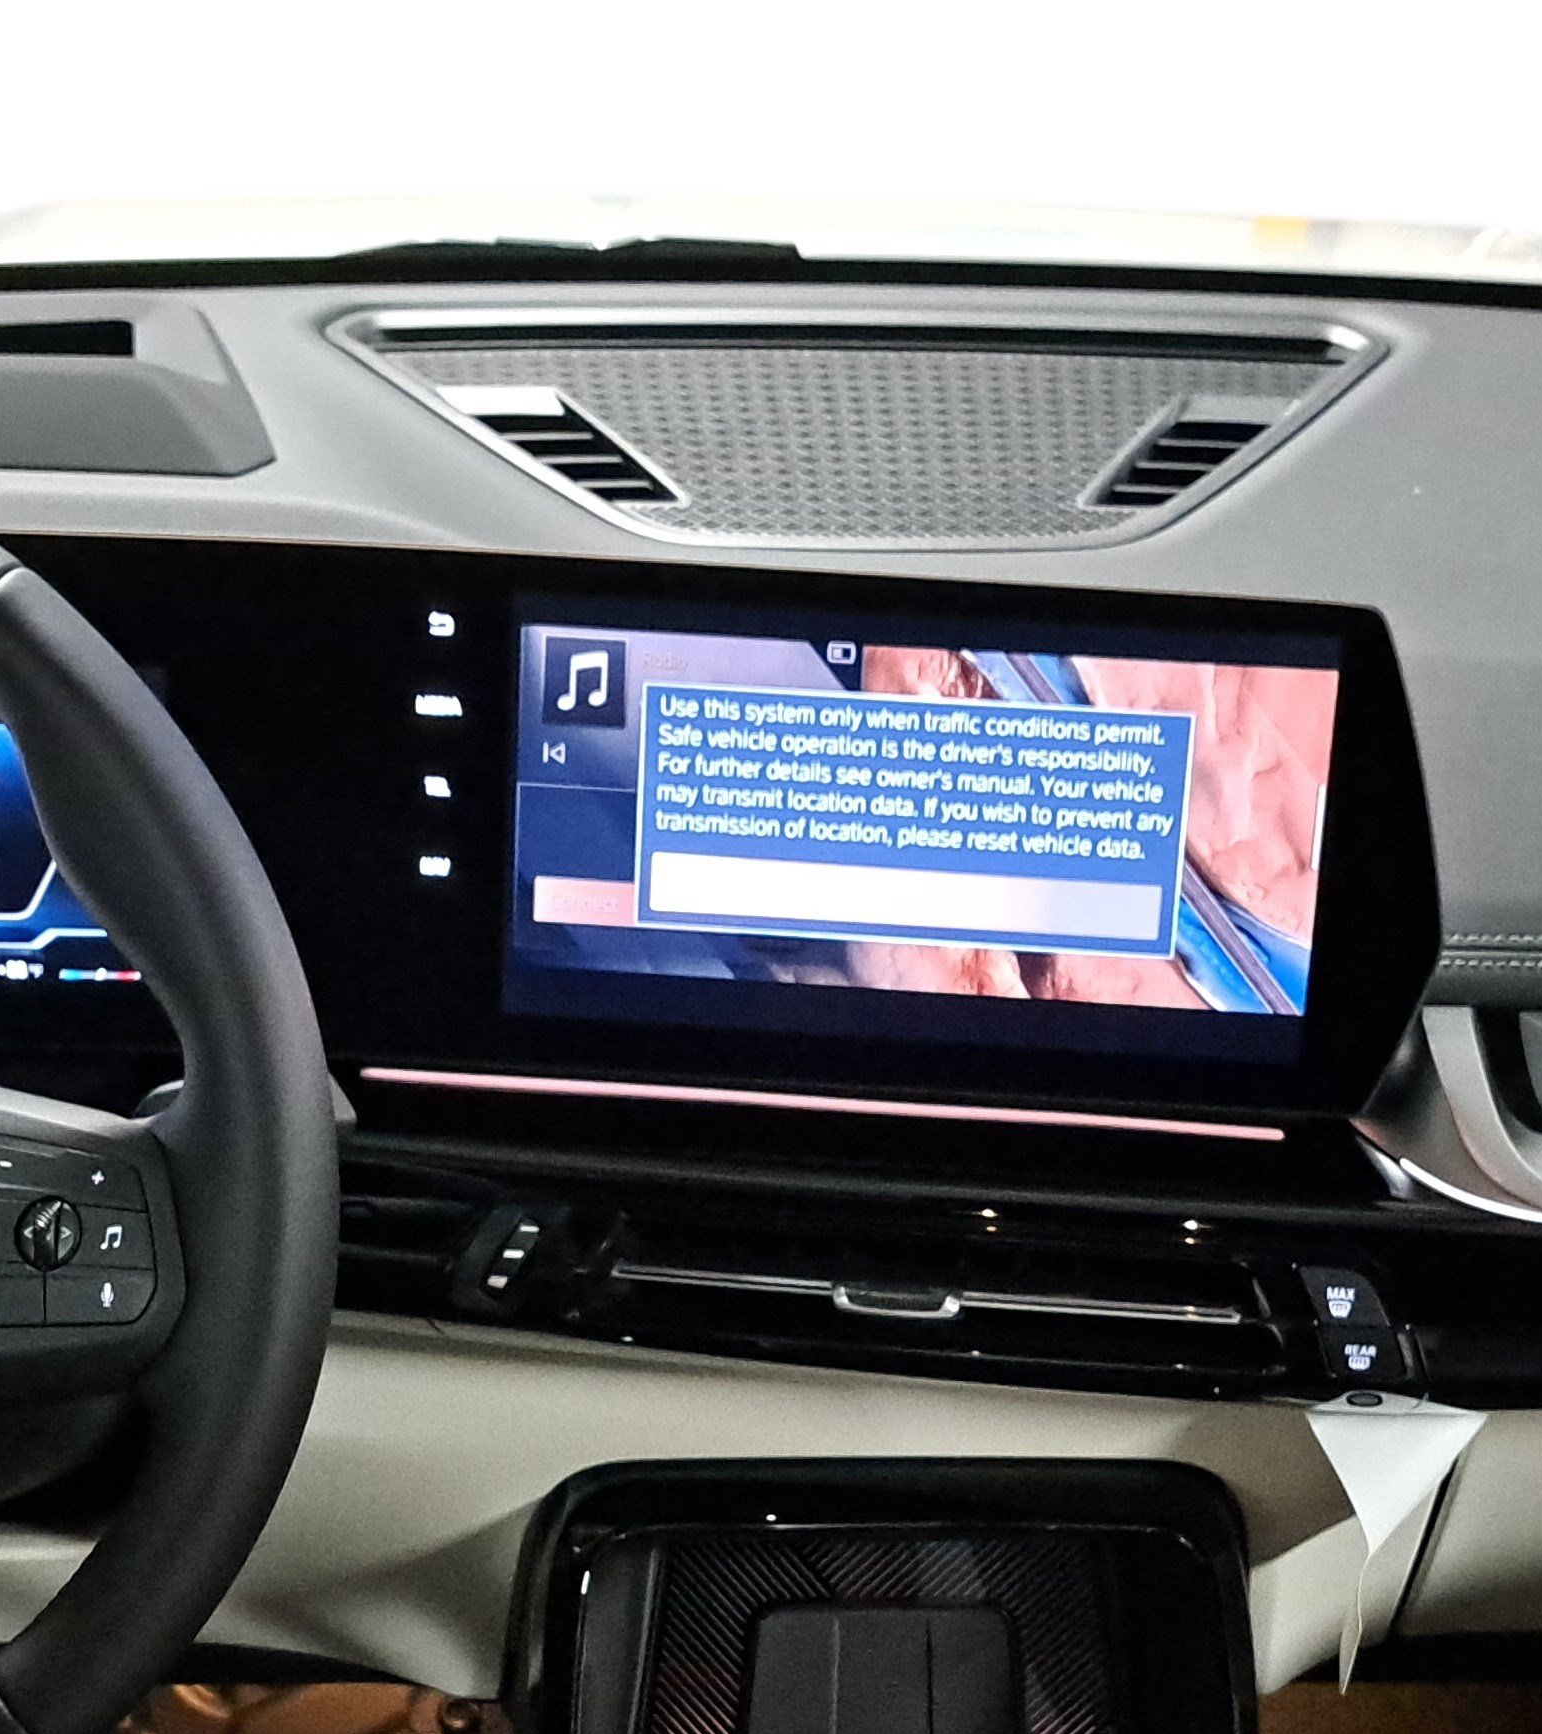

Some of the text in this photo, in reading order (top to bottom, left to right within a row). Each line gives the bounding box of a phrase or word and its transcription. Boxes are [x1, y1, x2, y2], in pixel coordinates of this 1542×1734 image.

[660, 694, 1165, 746] Use this system only when traffic conditions permit.
[659, 723, 1155, 777] Safe vehicle operation is the driver's responsibility.
[658, 751, 1163, 803] For further details see owner's manual. Your vehicle
[656, 783, 1173, 837] may transmit location data. If you wish to prevent any
[656, 809, 1146, 860] transmission of location, please reset vehicle data.
[1326, 1286, 1355, 1300] MAX
[1344, 1343, 1377, 1358] REAR
